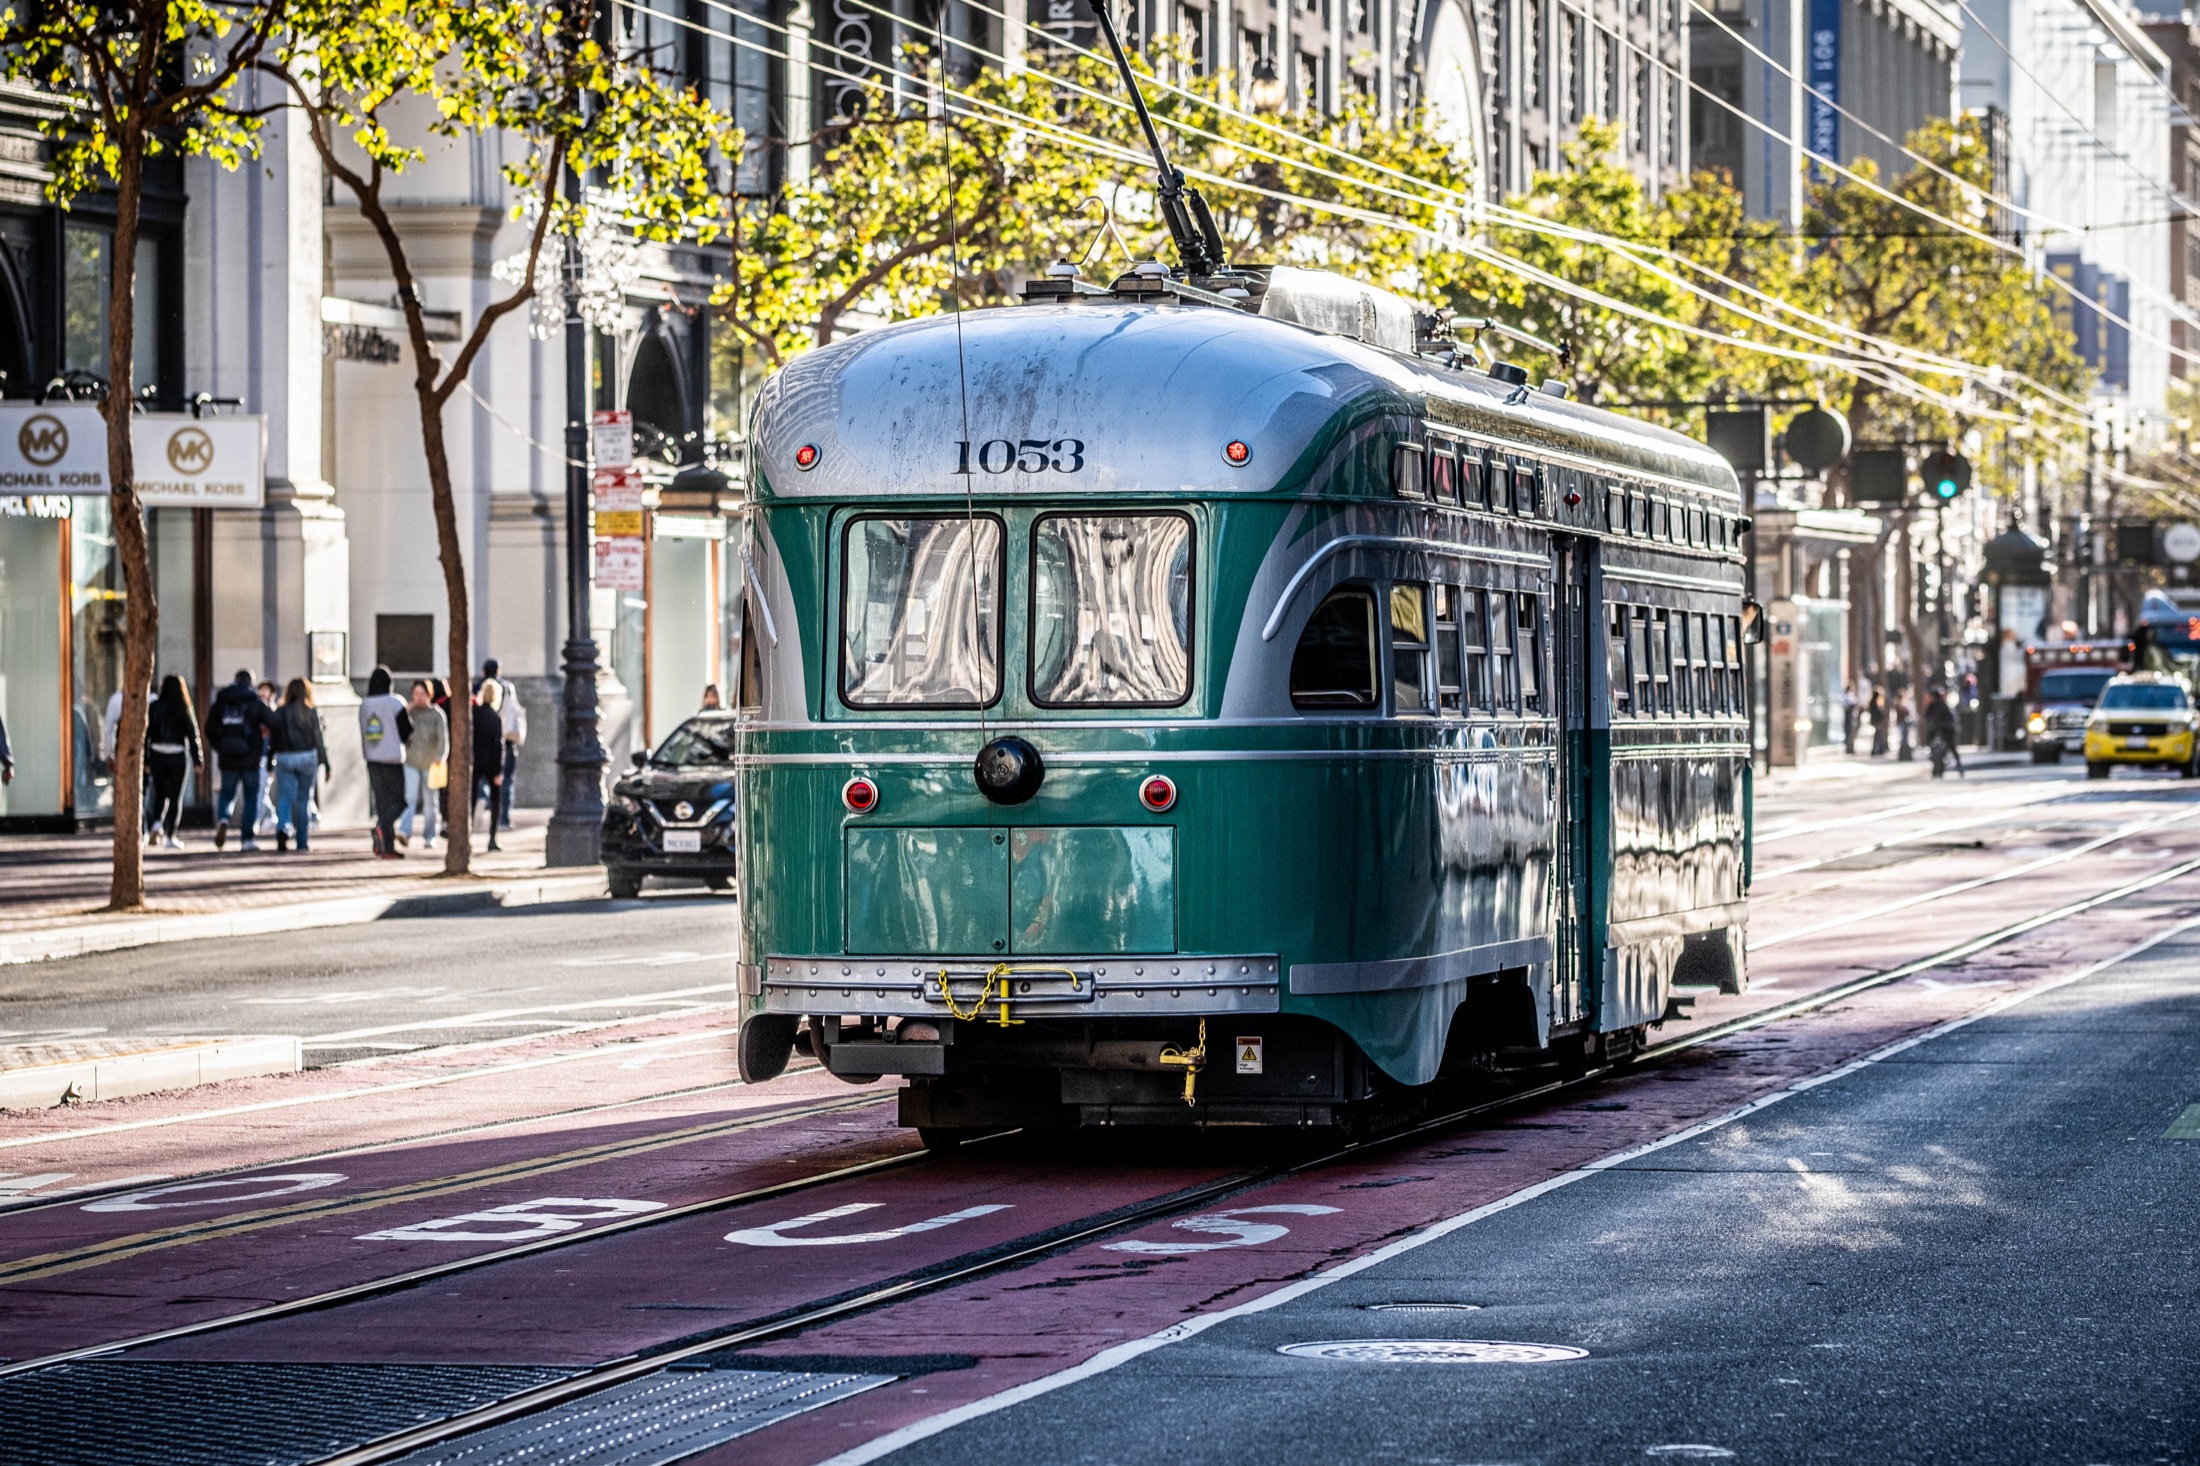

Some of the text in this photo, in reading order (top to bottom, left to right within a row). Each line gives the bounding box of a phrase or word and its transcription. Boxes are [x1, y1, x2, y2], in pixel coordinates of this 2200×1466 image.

[950, 438, 1085, 475] 1053
[59, 472, 102, 486] KORS
[205, 482, 245, 495] KORS
